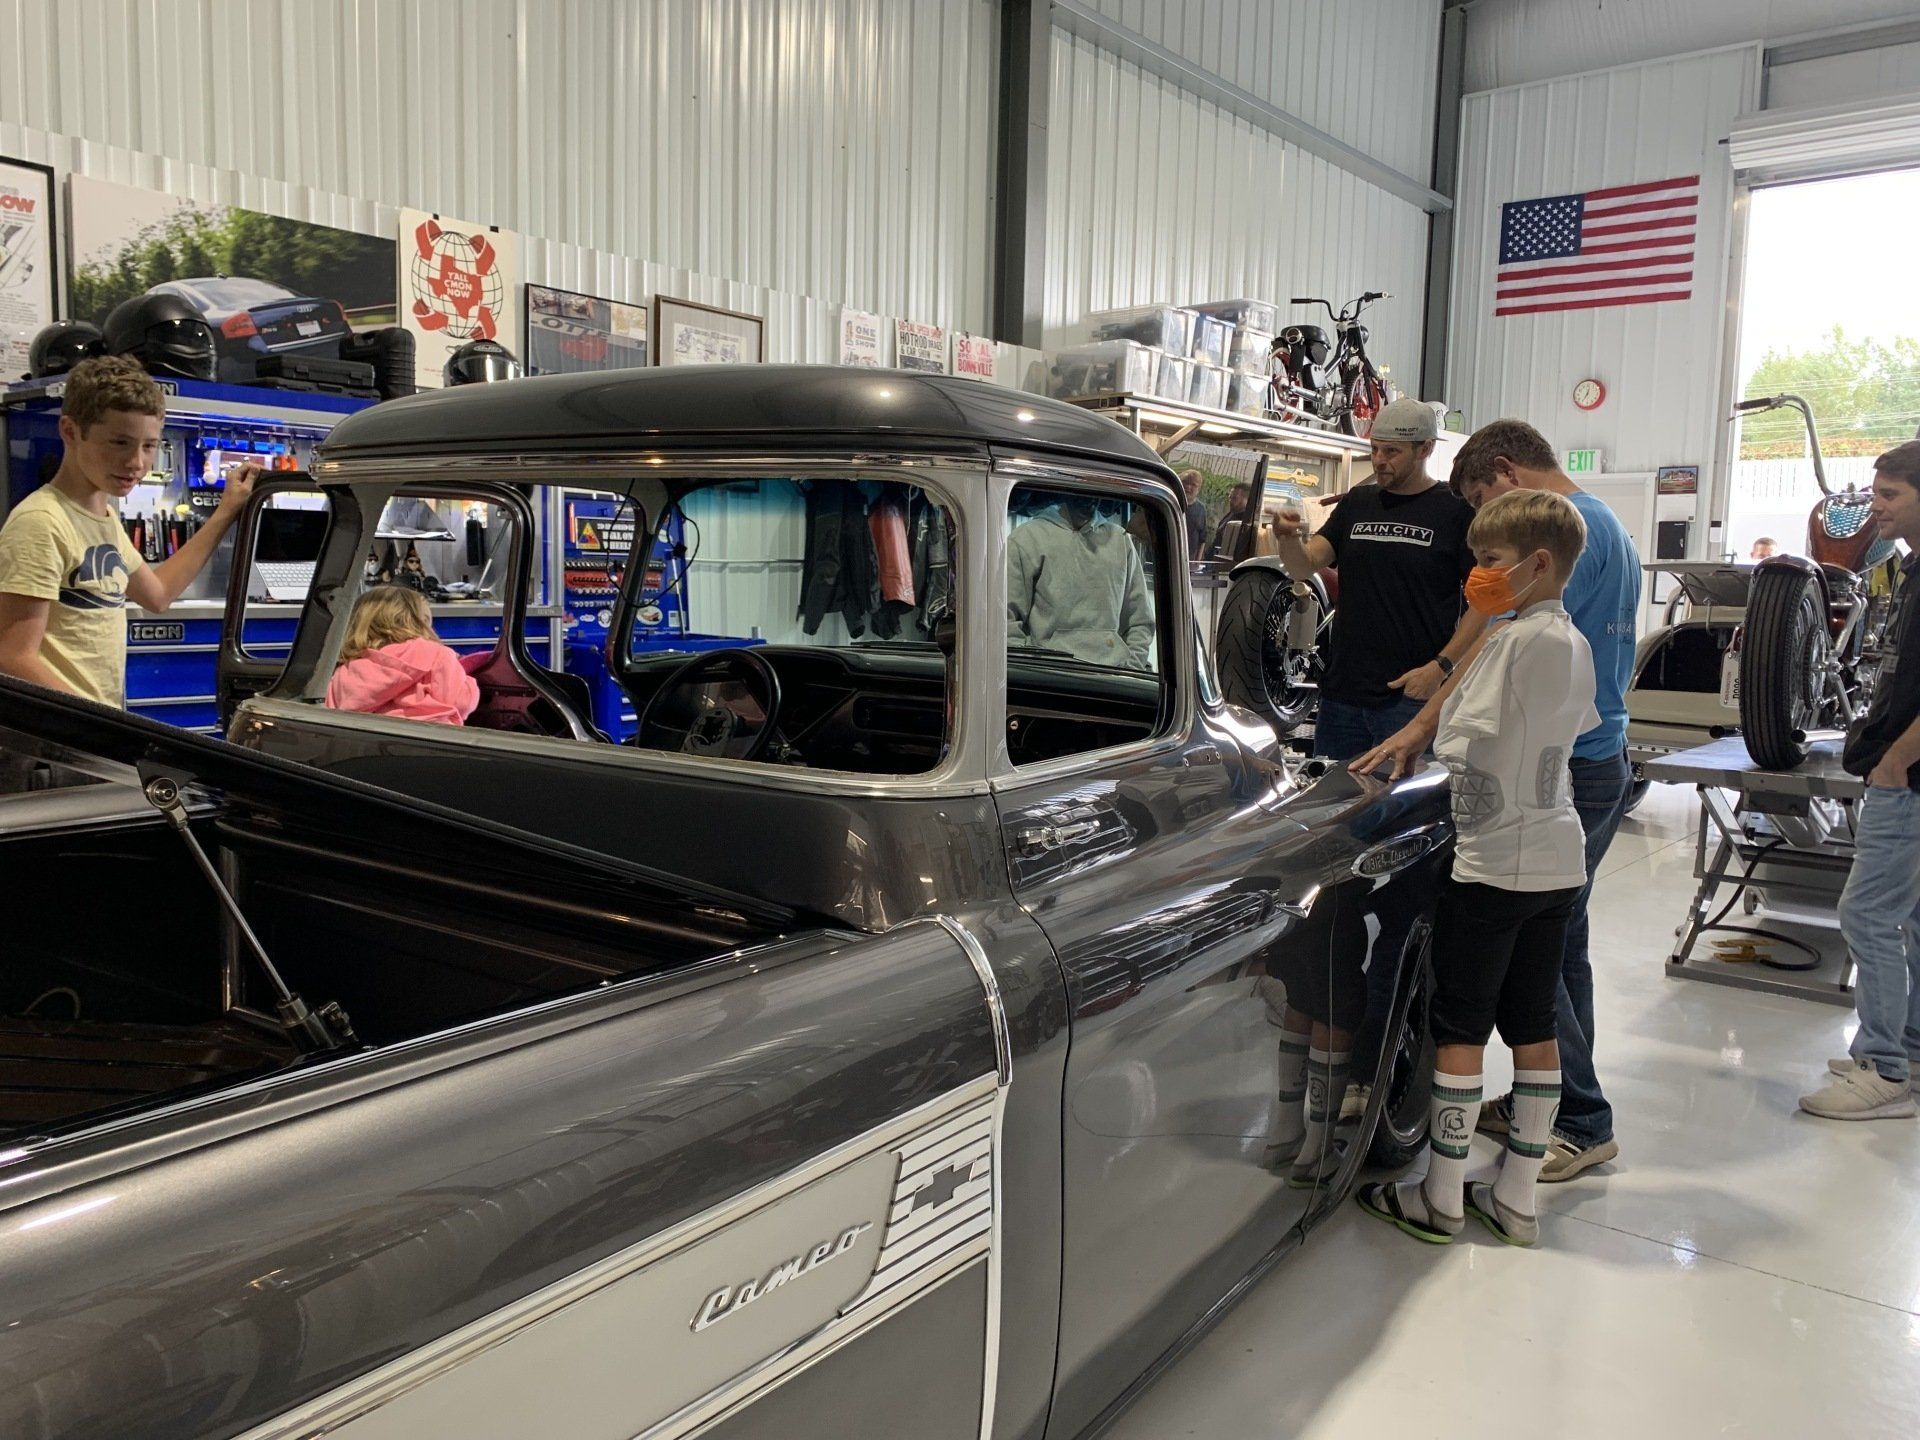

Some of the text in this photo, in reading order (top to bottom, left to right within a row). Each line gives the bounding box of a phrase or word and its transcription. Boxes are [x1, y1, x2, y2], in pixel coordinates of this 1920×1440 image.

[446, 288, 470, 298] NOW
[957, 358, 992, 377] BONNEVILLE
[1568, 451, 1595, 471] EXIT
[1354, 524, 1390, 533] RAIN
[1392, 525, 1430, 539] CITY
[133, 626, 181, 639] ICON
[689, 1220, 874, 1333] Cameo
